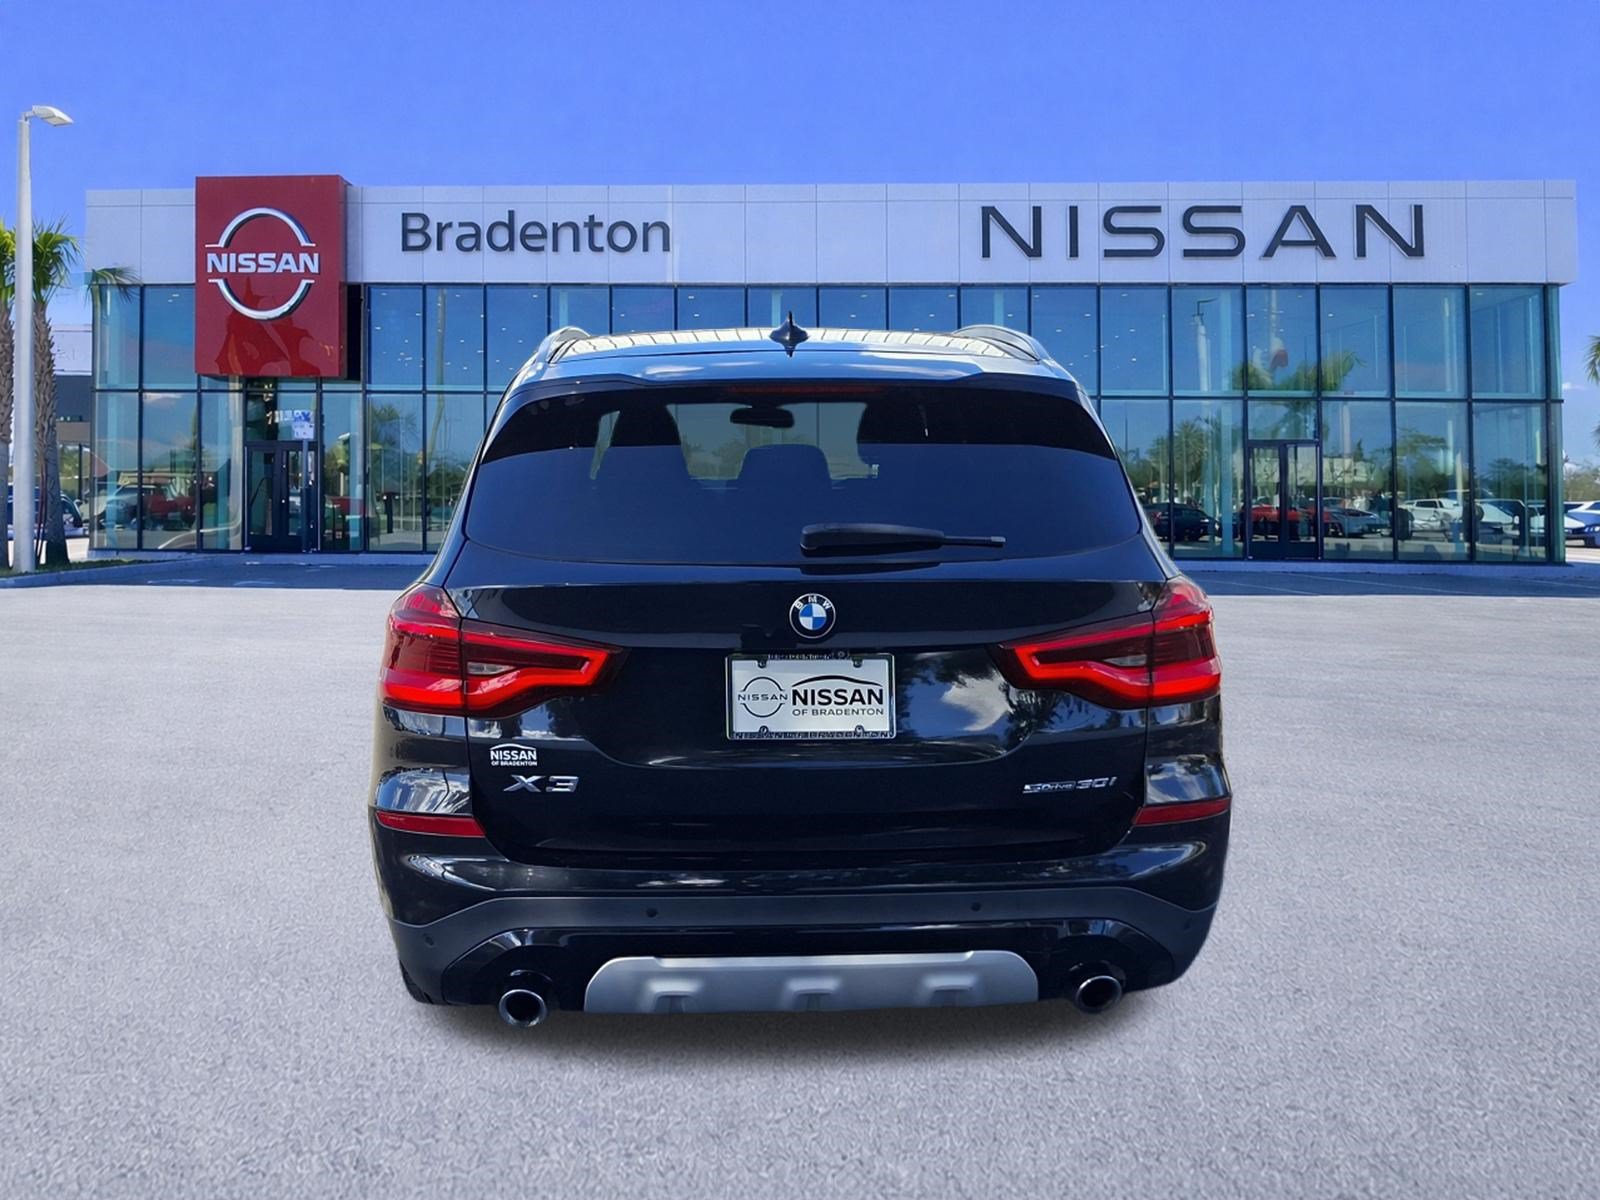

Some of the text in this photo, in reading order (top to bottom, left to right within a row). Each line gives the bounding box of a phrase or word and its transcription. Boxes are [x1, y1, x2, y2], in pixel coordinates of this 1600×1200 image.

[401, 210, 671, 253] Bradenton
[980, 204, 1425, 258] NISSAN
[206, 252, 320, 274] NISSAN
[794, 595, 831, 610] BMW
[737, 693, 788, 702] NISSAN
[792, 688, 884, 706] NISSAN
[792, 708, 884, 717] OF BRADENTON
[489, 750, 537, 761] NISSAN
[503, 774, 579, 793] X3
